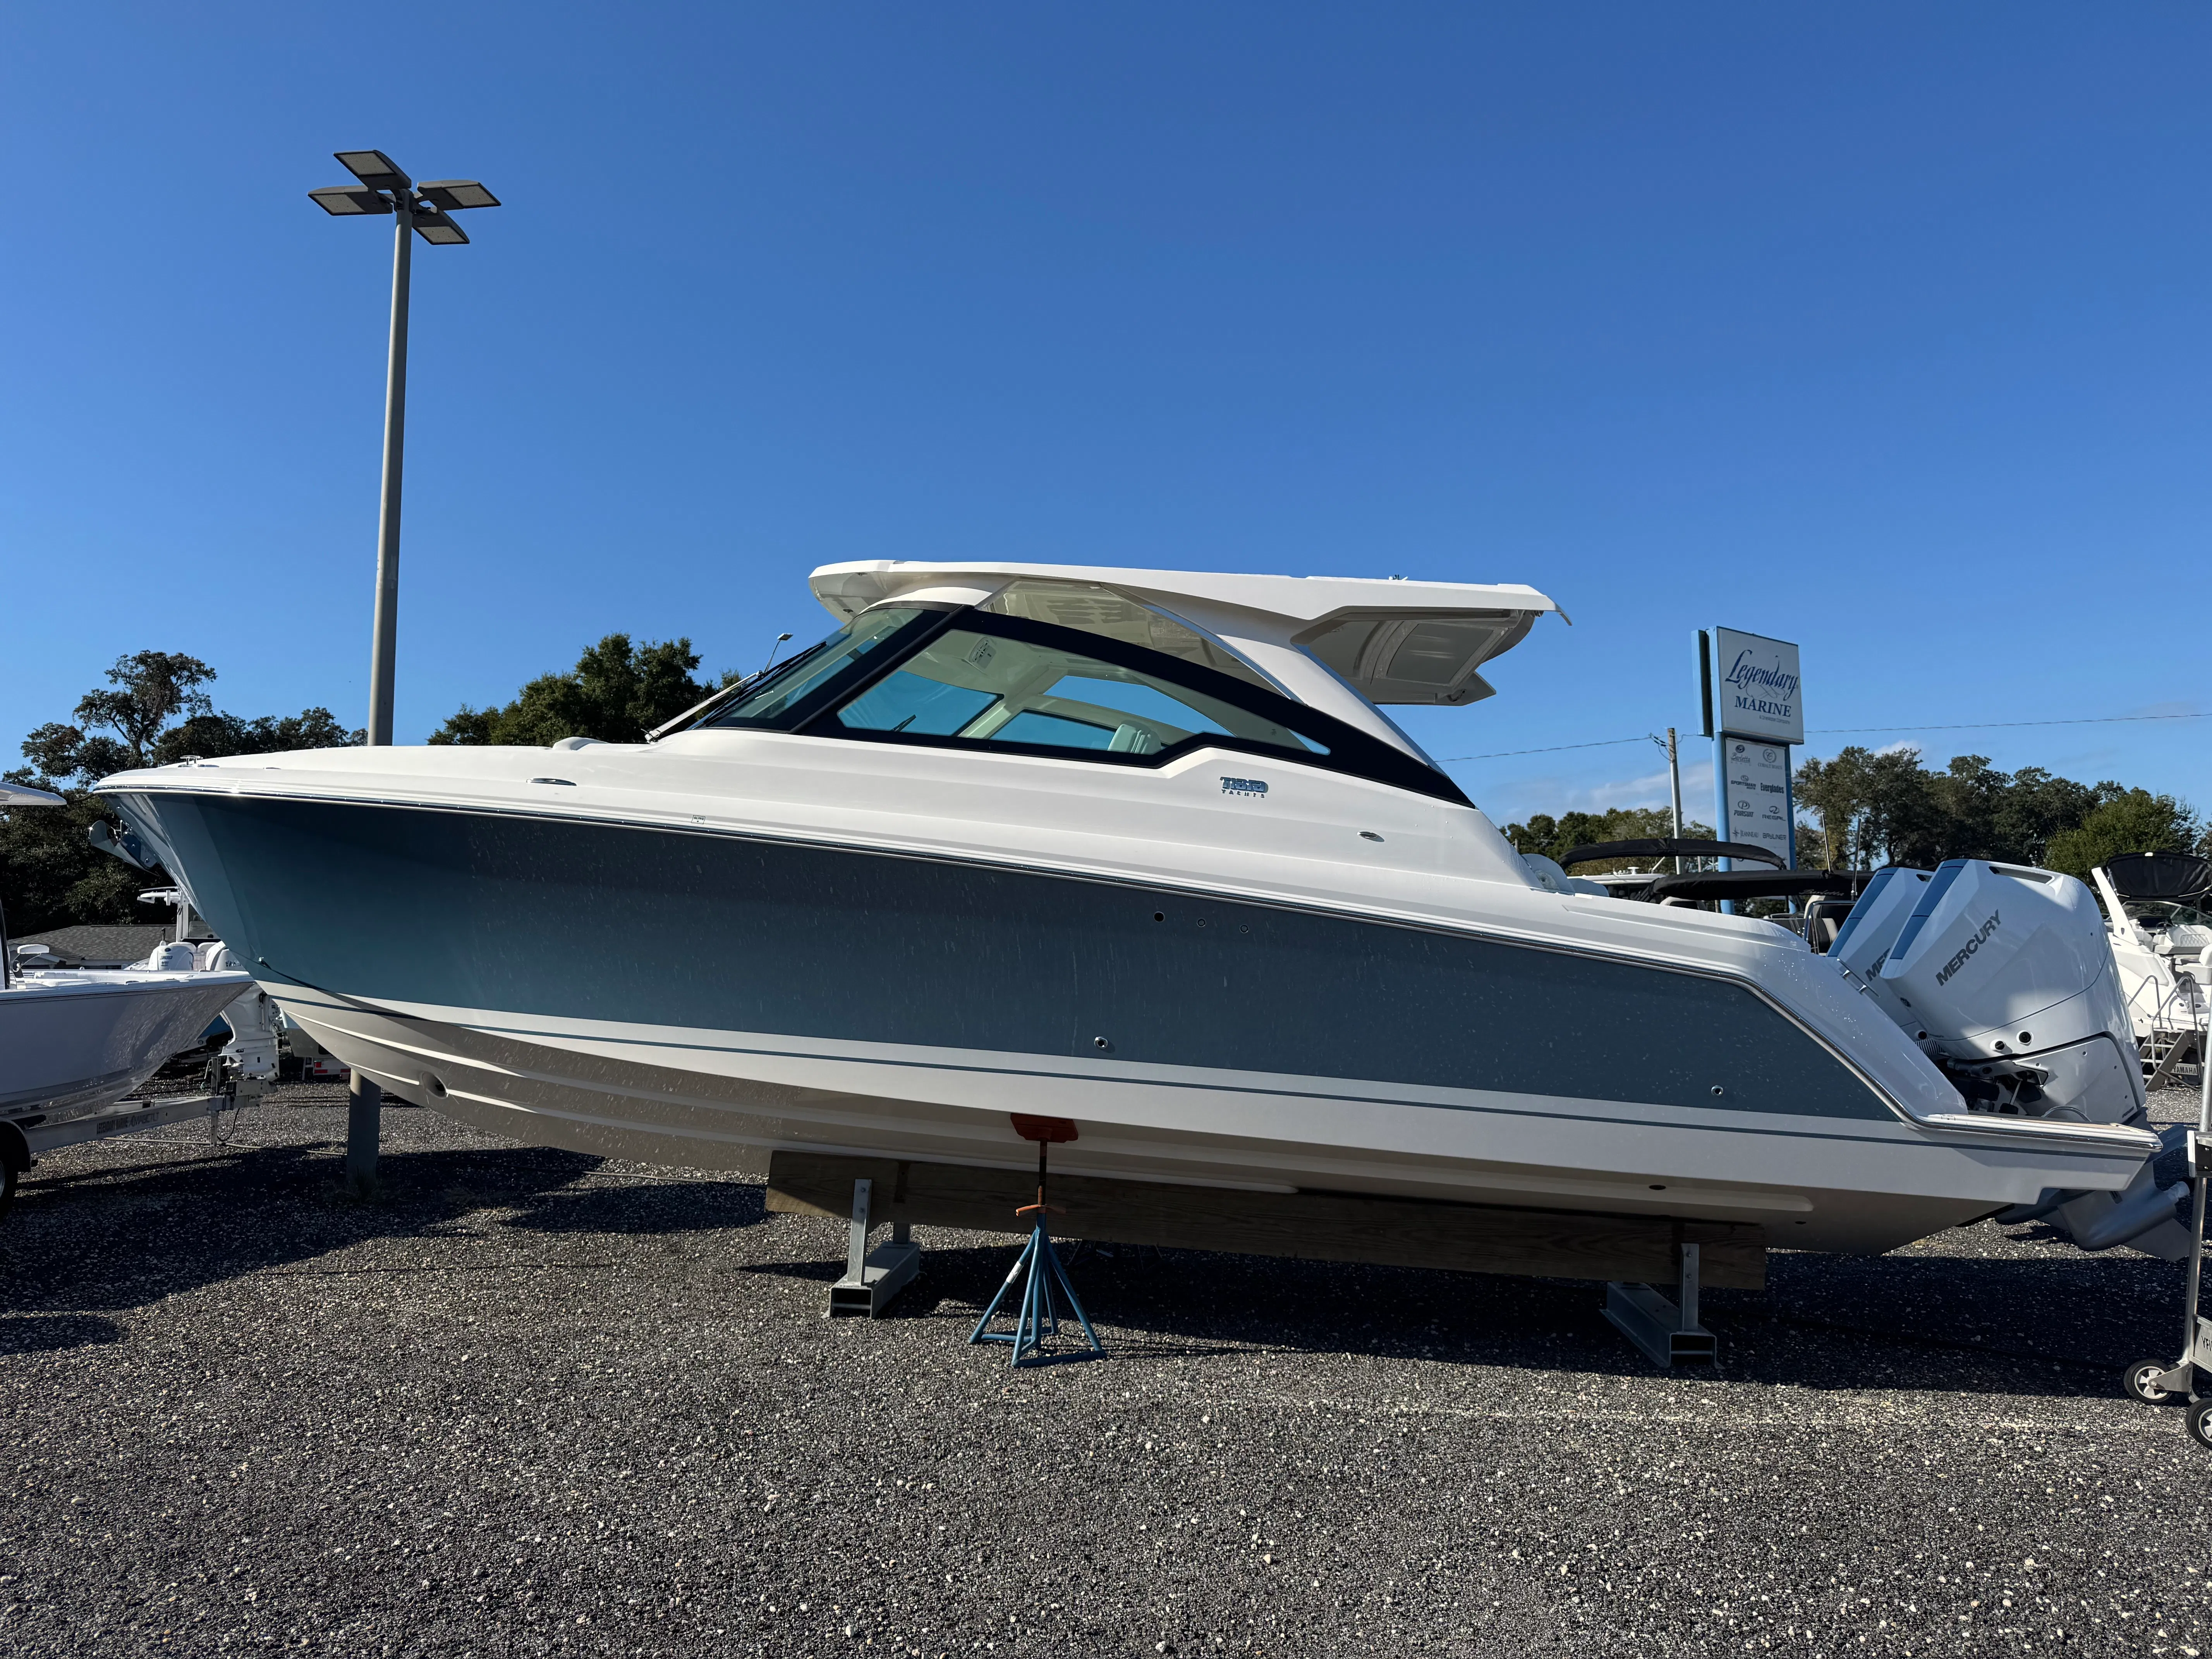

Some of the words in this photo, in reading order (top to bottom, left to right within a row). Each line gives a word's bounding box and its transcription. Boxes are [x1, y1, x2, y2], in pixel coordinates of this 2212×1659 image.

[1725, 649, 1798, 701] Legendary
[1735, 696, 1791, 717] MARINE
[1221, 789, 1265, 798] YACHTS
[1760, 783, 1784, 793] Everglades
[1740, 830, 1759, 838] JEANNEAU
[1936, 909, 2001, 986] MERCURY
[2201, 1335, 2212, 1352] YFI
